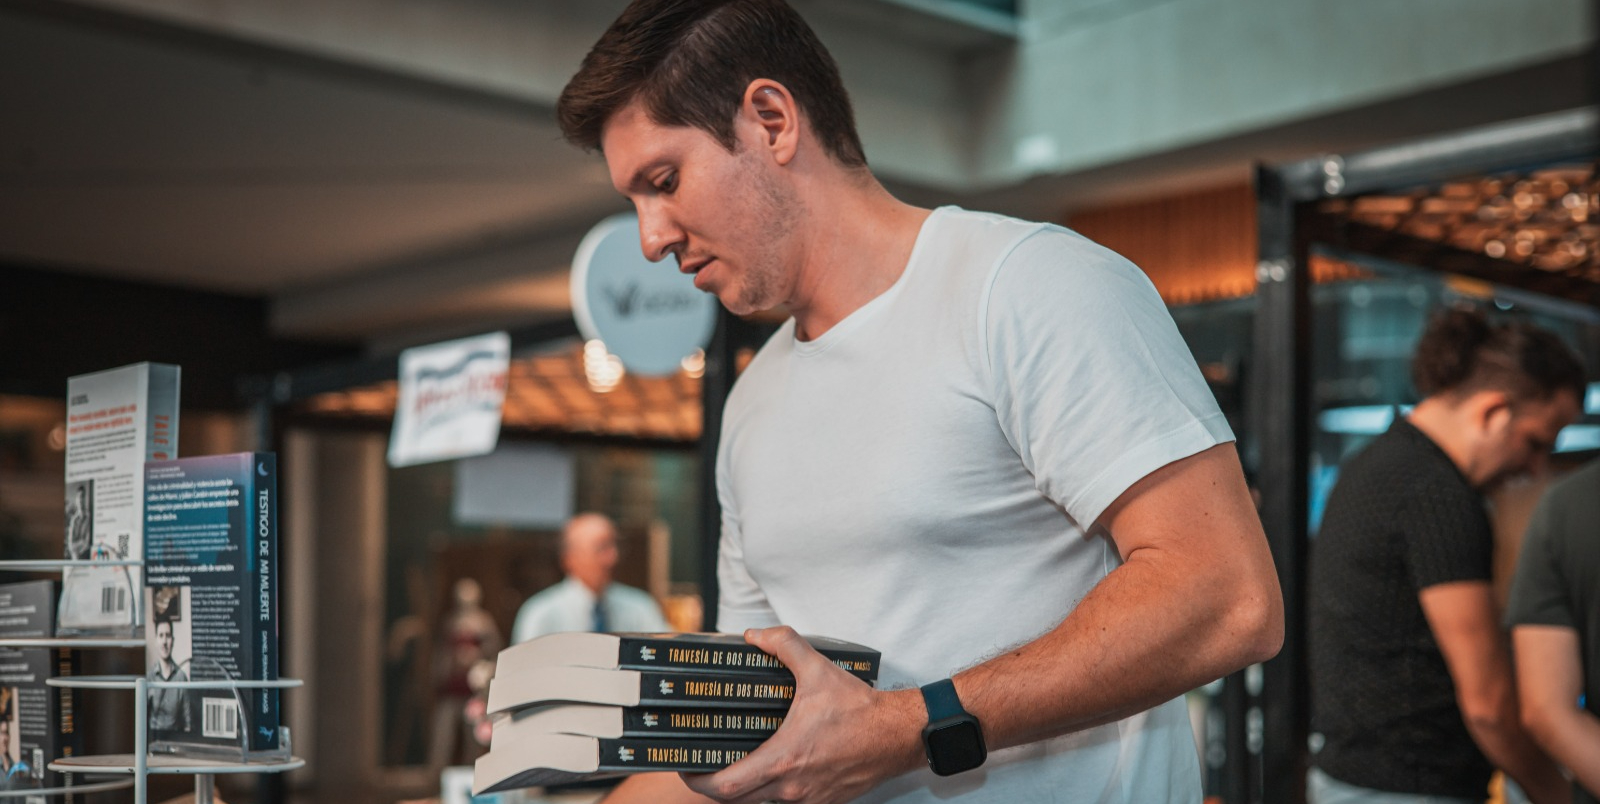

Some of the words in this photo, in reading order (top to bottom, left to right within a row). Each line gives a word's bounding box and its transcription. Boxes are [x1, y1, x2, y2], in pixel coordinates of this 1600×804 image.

[259, 489, 269, 537] TESTIGO
[259, 540, 269, 556] DE
[259, 559, 269, 574] MI
[260, 575, 270, 621] MUERTE
[668, 647, 709, 664] TRAVESÍA
[713, 651, 723, 665] DE
[726, 652, 743, 666] DOS
[745, 652, 788, 669] HERMANO
[853, 660, 871, 671] MASÍS
[685, 680, 721, 696] TRAVESÍA
[725, 683, 734, 697] DE
[737, 684, 752, 698] DOS
[754, 684, 794, 699] HERMANOS
[671, 713, 710, 729] TRAVESÍA
[713, 714, 723, 729] DE
[726, 715, 742, 729] DOS
[647, 747, 688, 763] TRAVESÍA
[692, 749, 702, 763] DE
[706, 750, 722, 764] DOS
